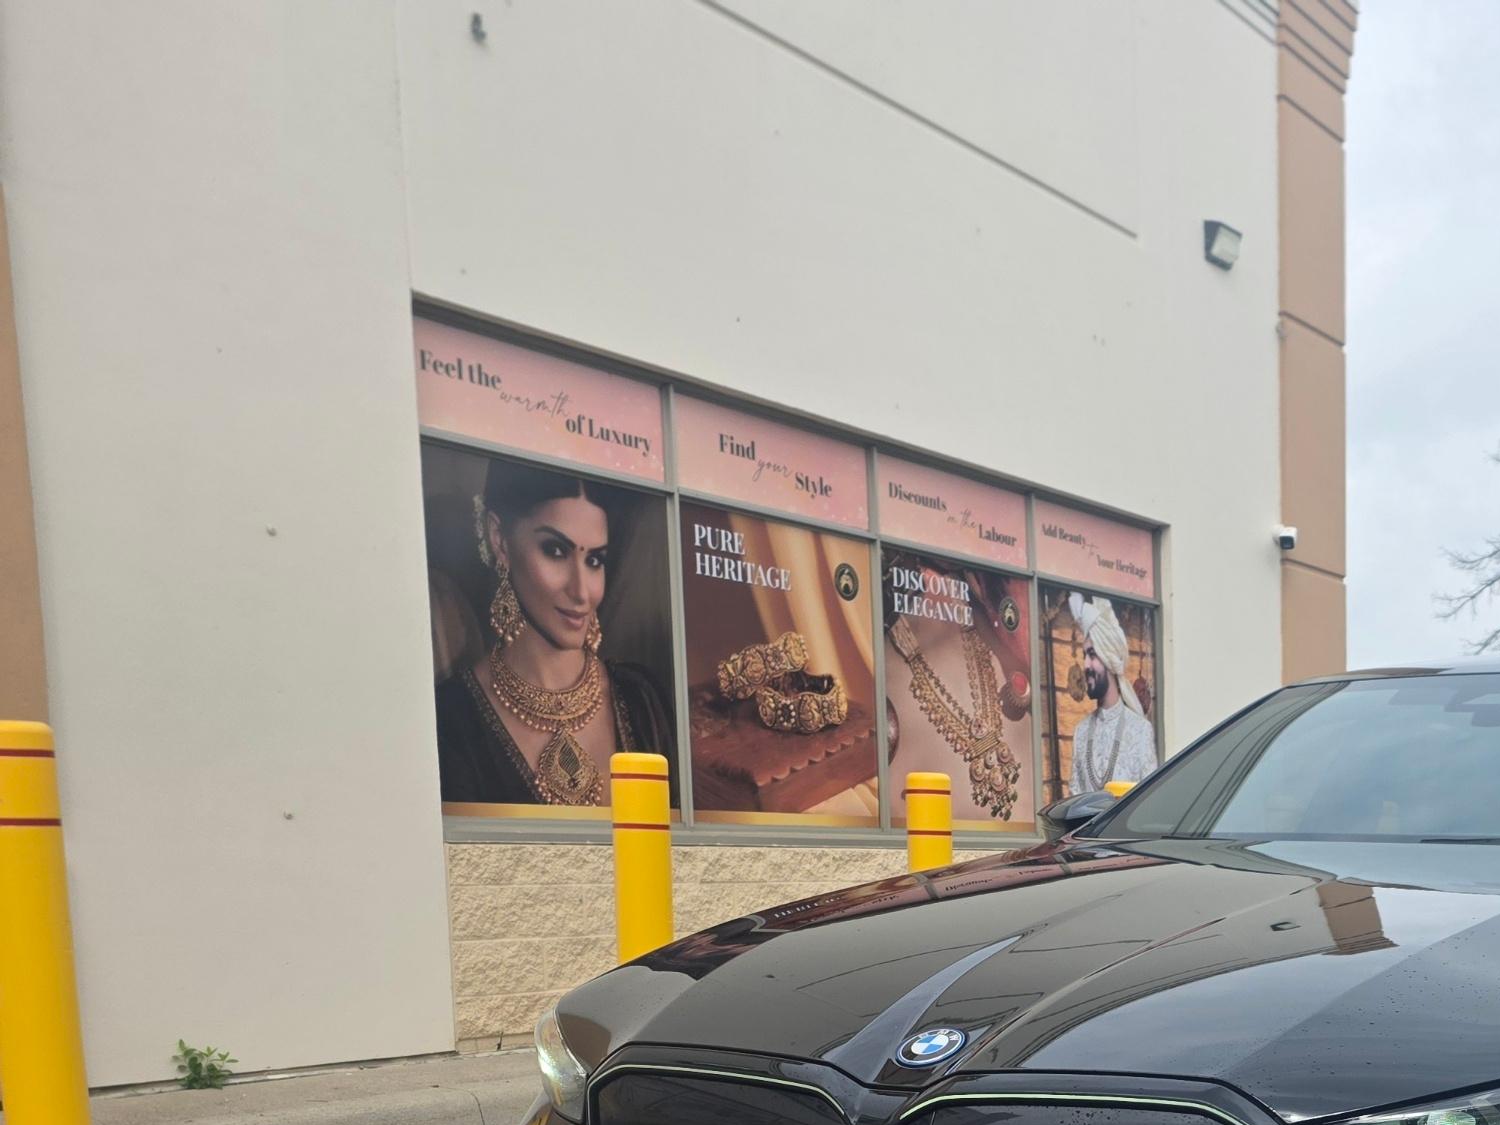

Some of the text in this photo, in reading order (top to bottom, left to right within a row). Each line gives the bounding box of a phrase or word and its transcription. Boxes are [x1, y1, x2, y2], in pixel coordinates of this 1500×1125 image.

[420, 350, 502, 390] Feel the
[500, 391, 569, 418] warmth
[566, 414, 651, 456] of Luxury
[719, 434, 755, 460] Find
[753, 458, 793, 482] your
[795, 472, 832, 499] Style
[888, 482, 947, 512] Discounts
[960, 507, 977, 528] the
[694, 524, 745, 555] PURE
[979, 524, 1017, 547] Labour
[1058, 528, 1086, 550] Beauty
[695, 552, 791, 591] HERITAGE
[1097, 554, 1147, 579] Your Heritage
[892, 567, 970, 602] DISCOVER
[893, 592, 974, 626] ELEGANCE
